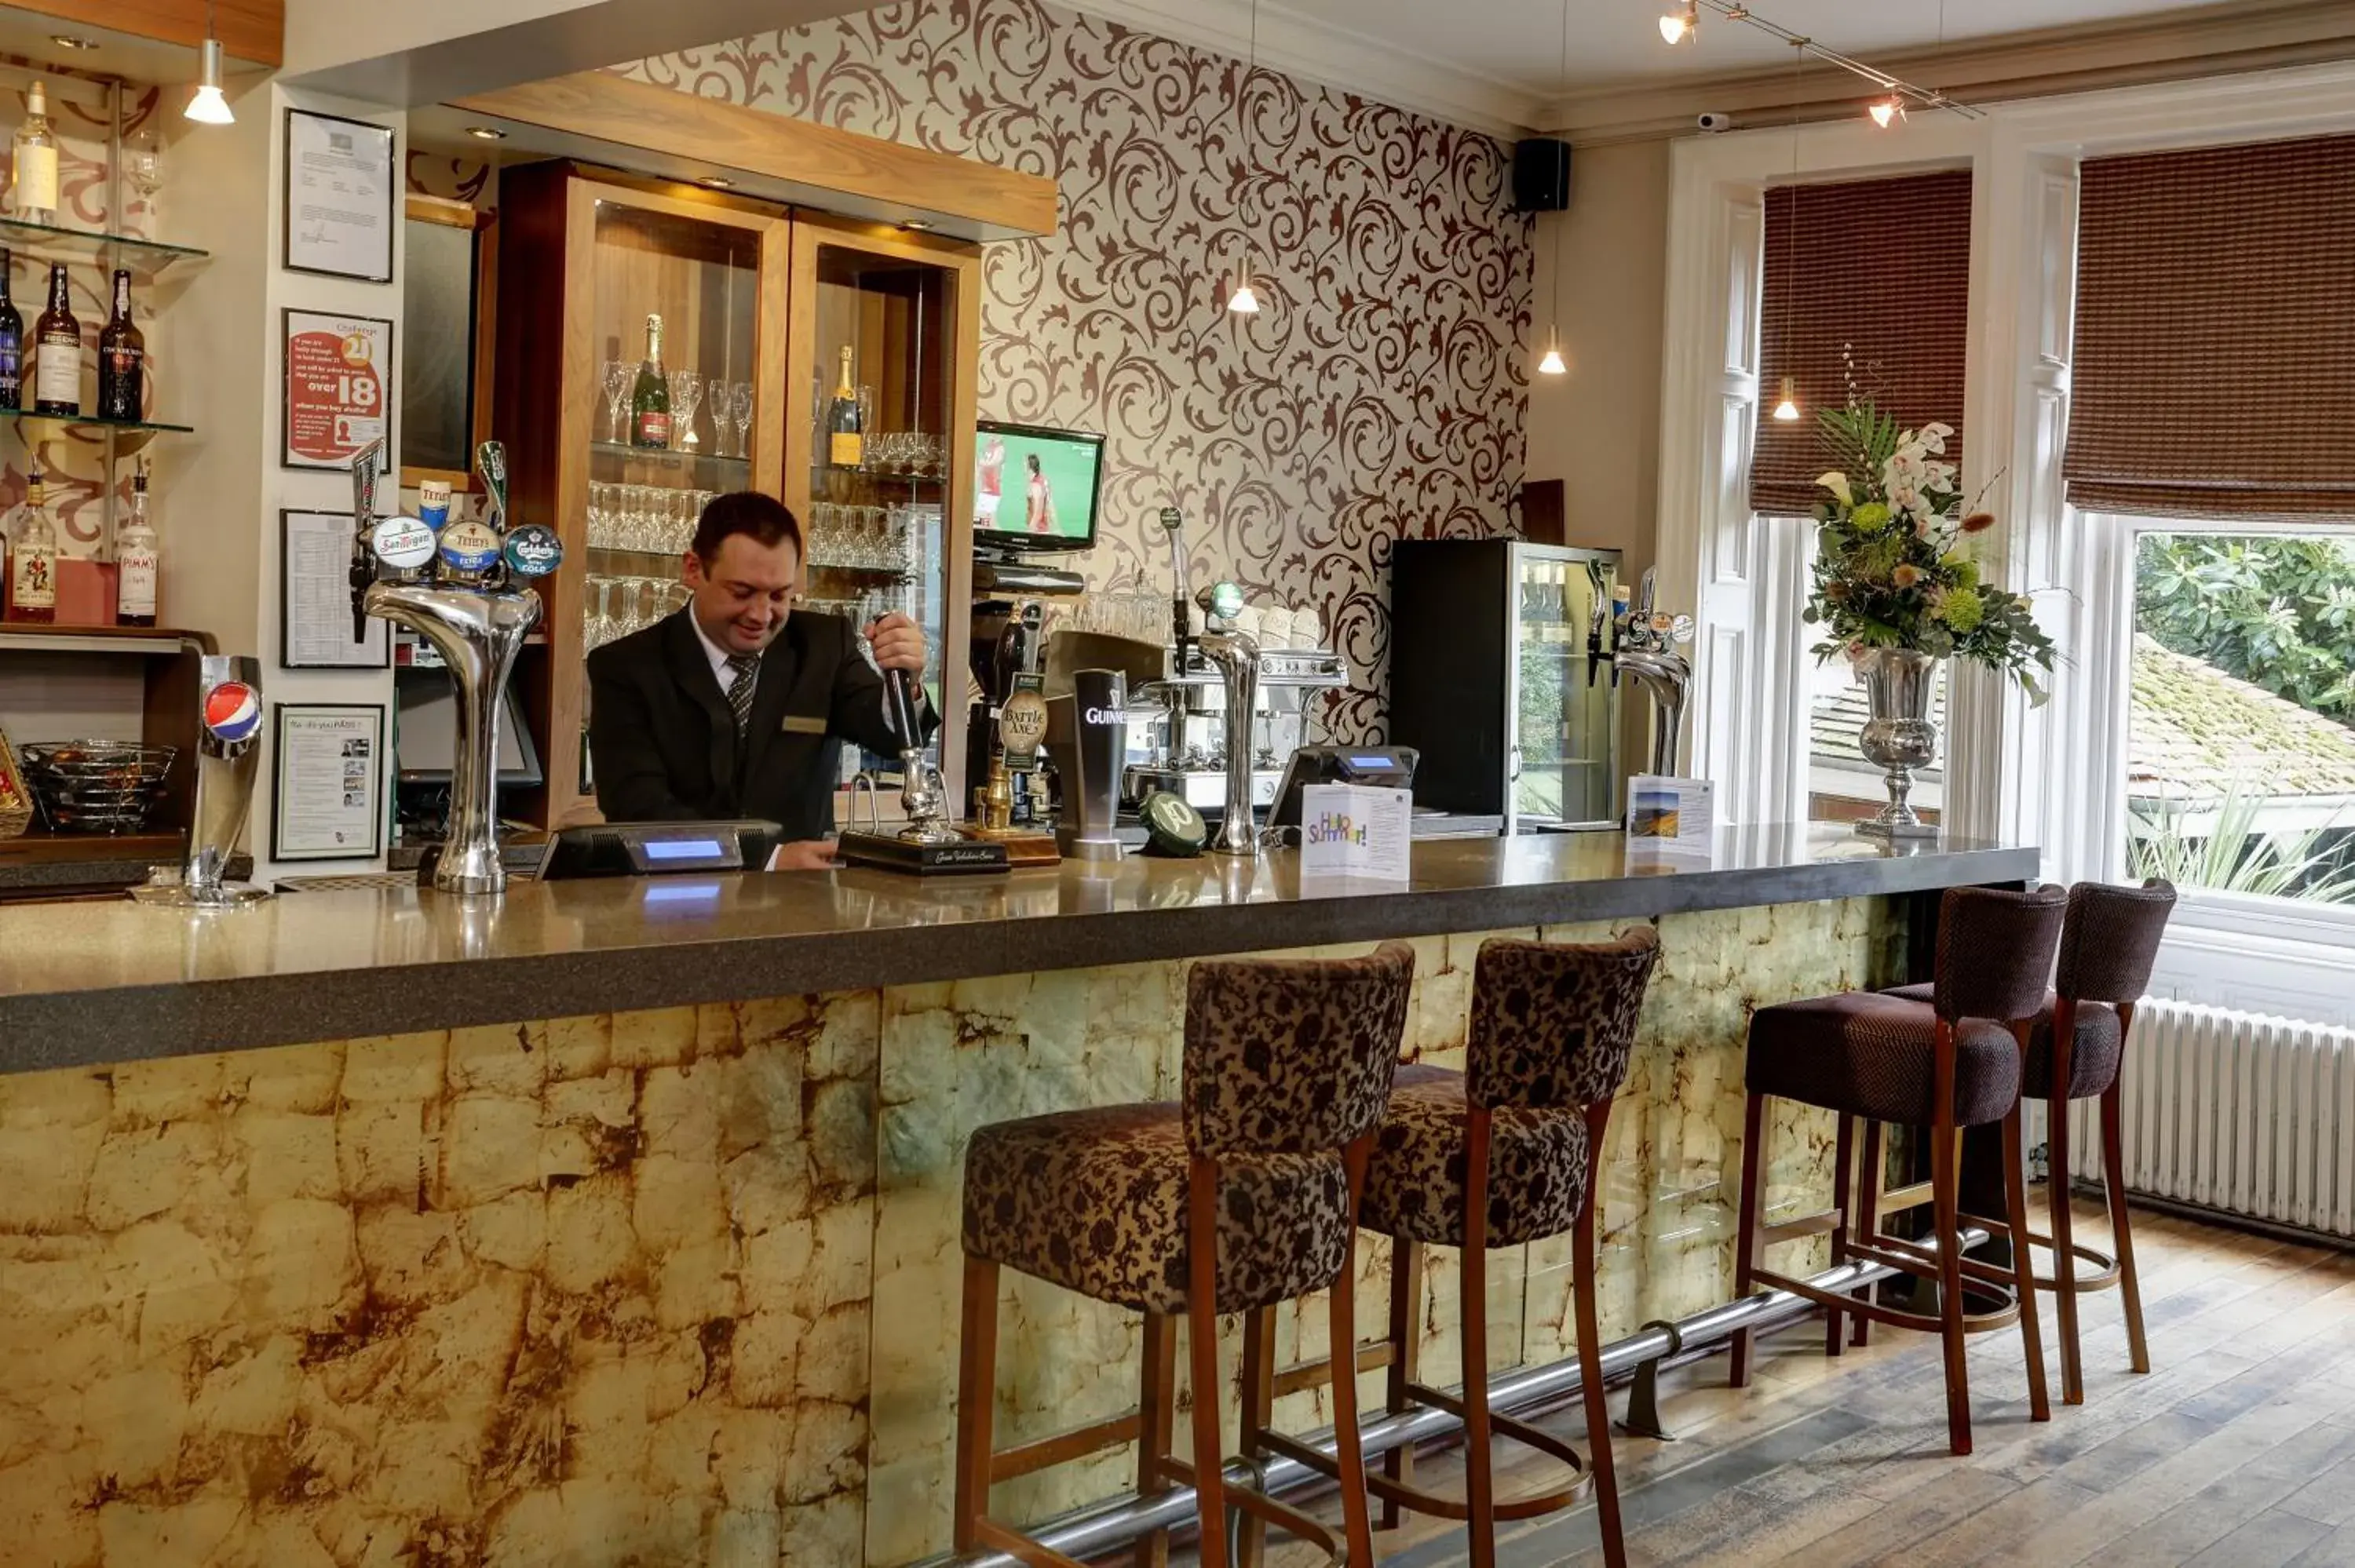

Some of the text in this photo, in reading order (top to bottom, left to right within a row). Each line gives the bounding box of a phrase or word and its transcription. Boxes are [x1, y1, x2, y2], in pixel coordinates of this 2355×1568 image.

[308, 376, 376, 407] over 18
[521, 564, 546, 573] COLD
[1006, 708, 1045, 723] BATTLE
[1321, 811, 1351, 833] Hello
